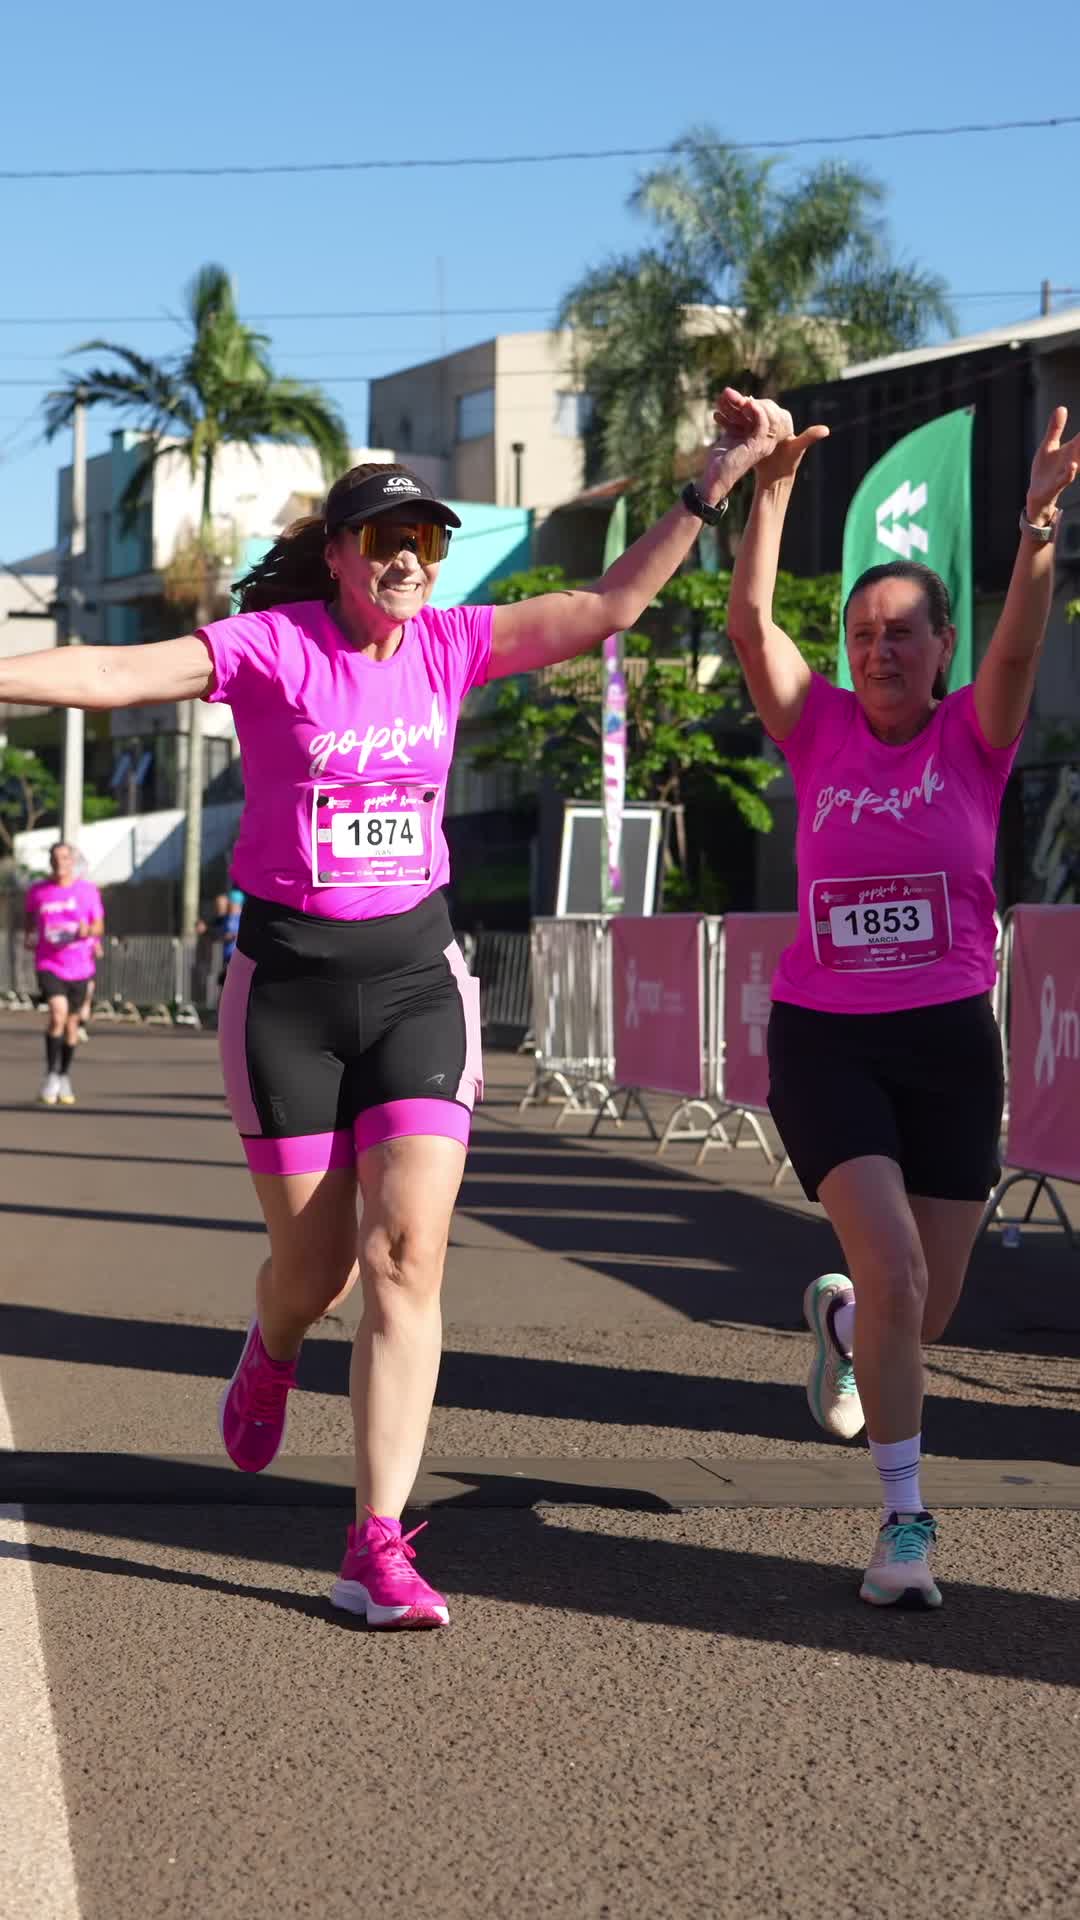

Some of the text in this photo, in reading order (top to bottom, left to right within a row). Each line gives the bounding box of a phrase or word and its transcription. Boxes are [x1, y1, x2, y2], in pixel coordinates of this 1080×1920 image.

[348, 818, 413, 846] 1874
[844, 905, 920, 936] 1853
[868, 936, 899, 944] MARCIA
